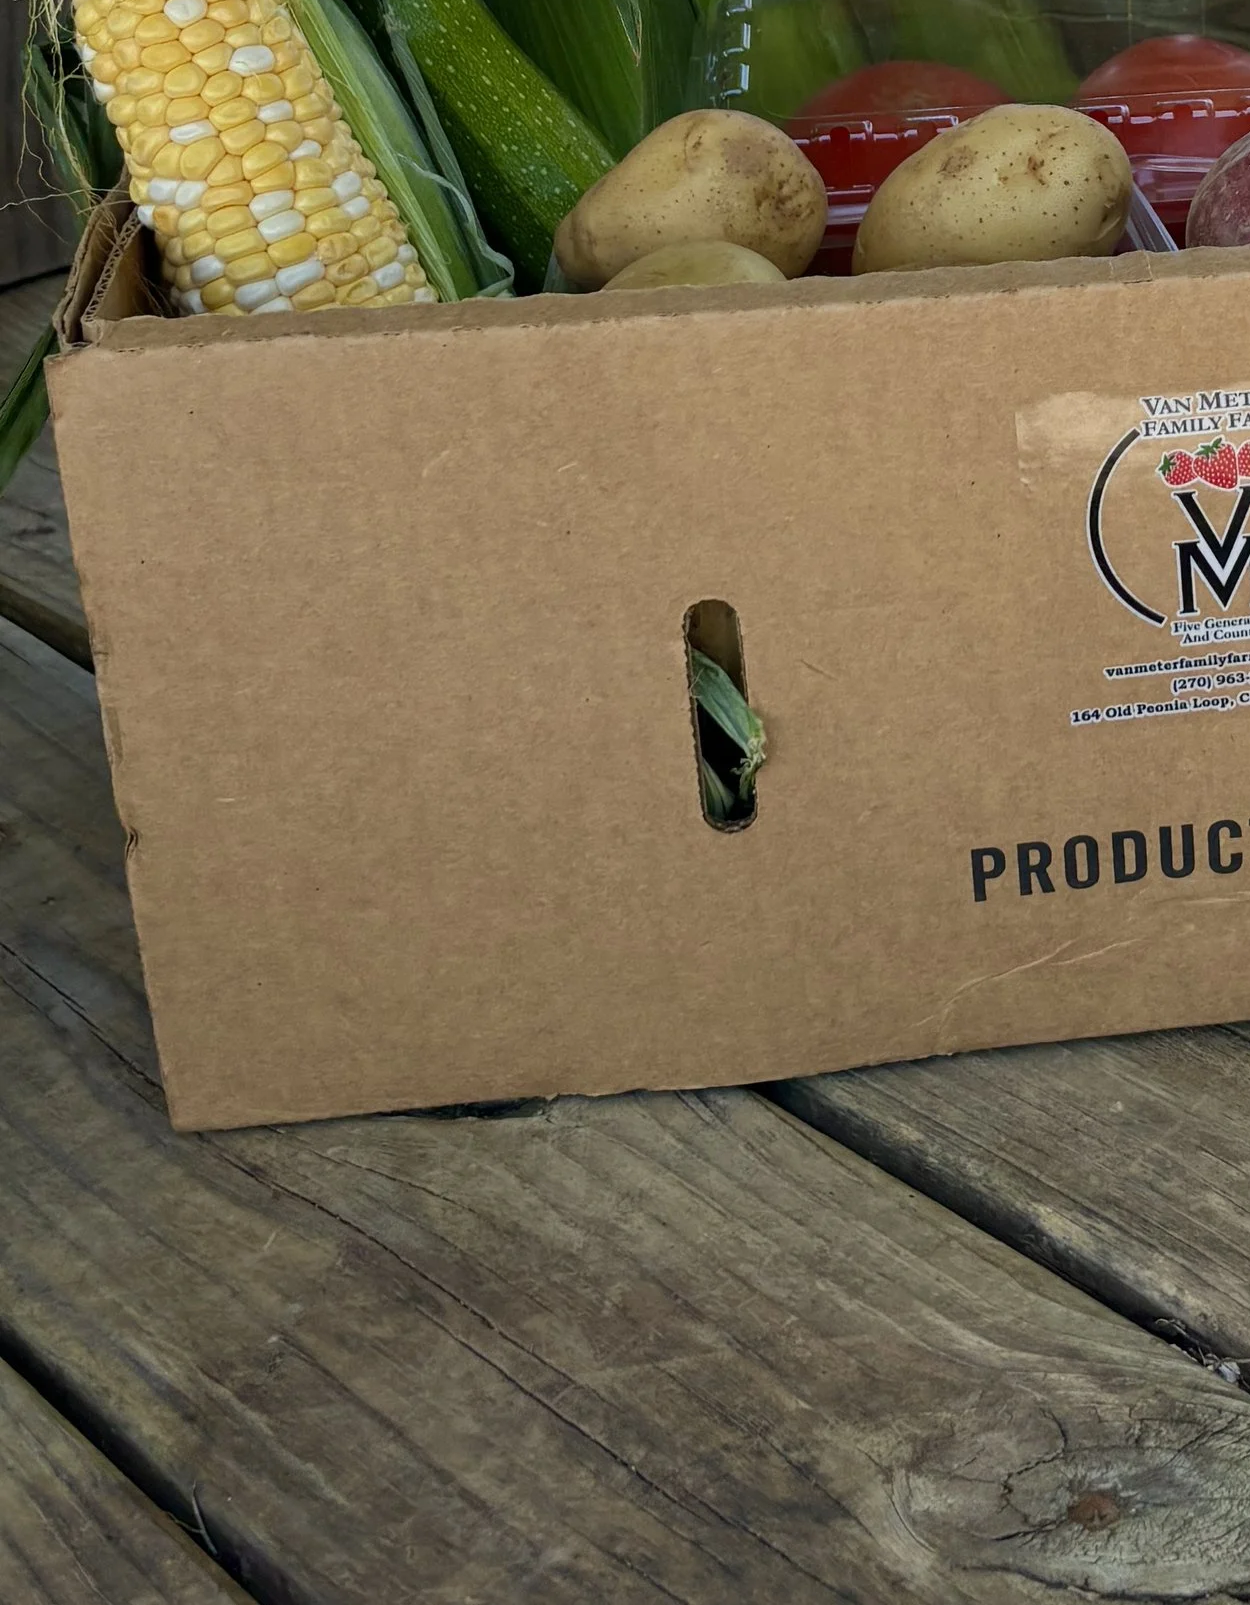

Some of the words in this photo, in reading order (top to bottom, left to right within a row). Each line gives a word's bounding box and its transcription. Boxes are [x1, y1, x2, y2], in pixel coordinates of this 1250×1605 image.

[1142, 396, 1191, 416] VAN
[1142, 416, 1222, 437] FAMILY
[1173, 621, 1200, 633] Five
[1182, 631, 1209, 644] And
[1172, 676, 1212, 693] (270)
[1072, 709, 1100, 723] 164
[1105, 705, 1132, 719] Old
[1137, 699, 1188, 715] Peonia
[1193, 697, 1235, 710] Loop,
